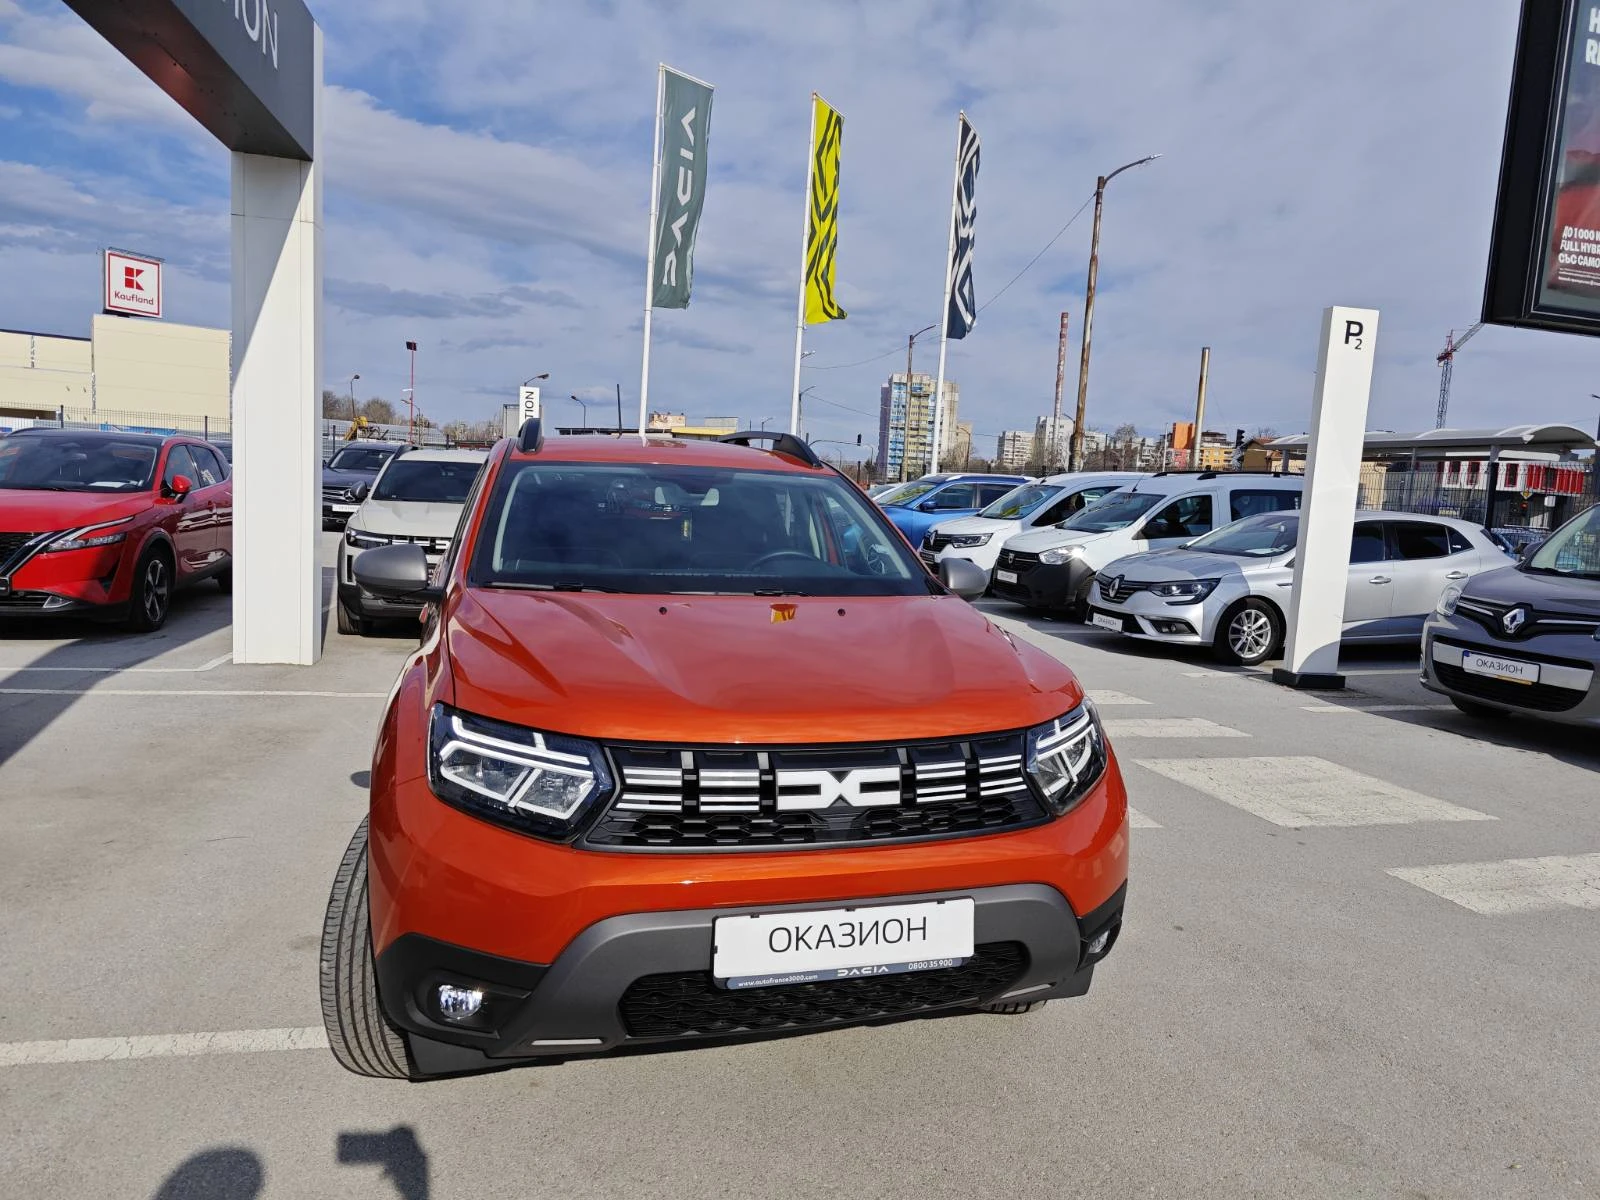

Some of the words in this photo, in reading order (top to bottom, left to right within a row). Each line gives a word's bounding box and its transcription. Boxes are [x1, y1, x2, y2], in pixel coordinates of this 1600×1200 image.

[1560, 240, 1580, 251] FULL
[114, 291, 154, 305] Kaufland
[1476, 659, 1523, 674] ОКАЗИОН
[768, 916, 927, 953] ОКАЗИОН
[837, 965, 889, 977] DACIA
[908, 961, 928, 970] 0800
[929, 960, 938, 968] 35
[939, 958, 953, 968] 900
